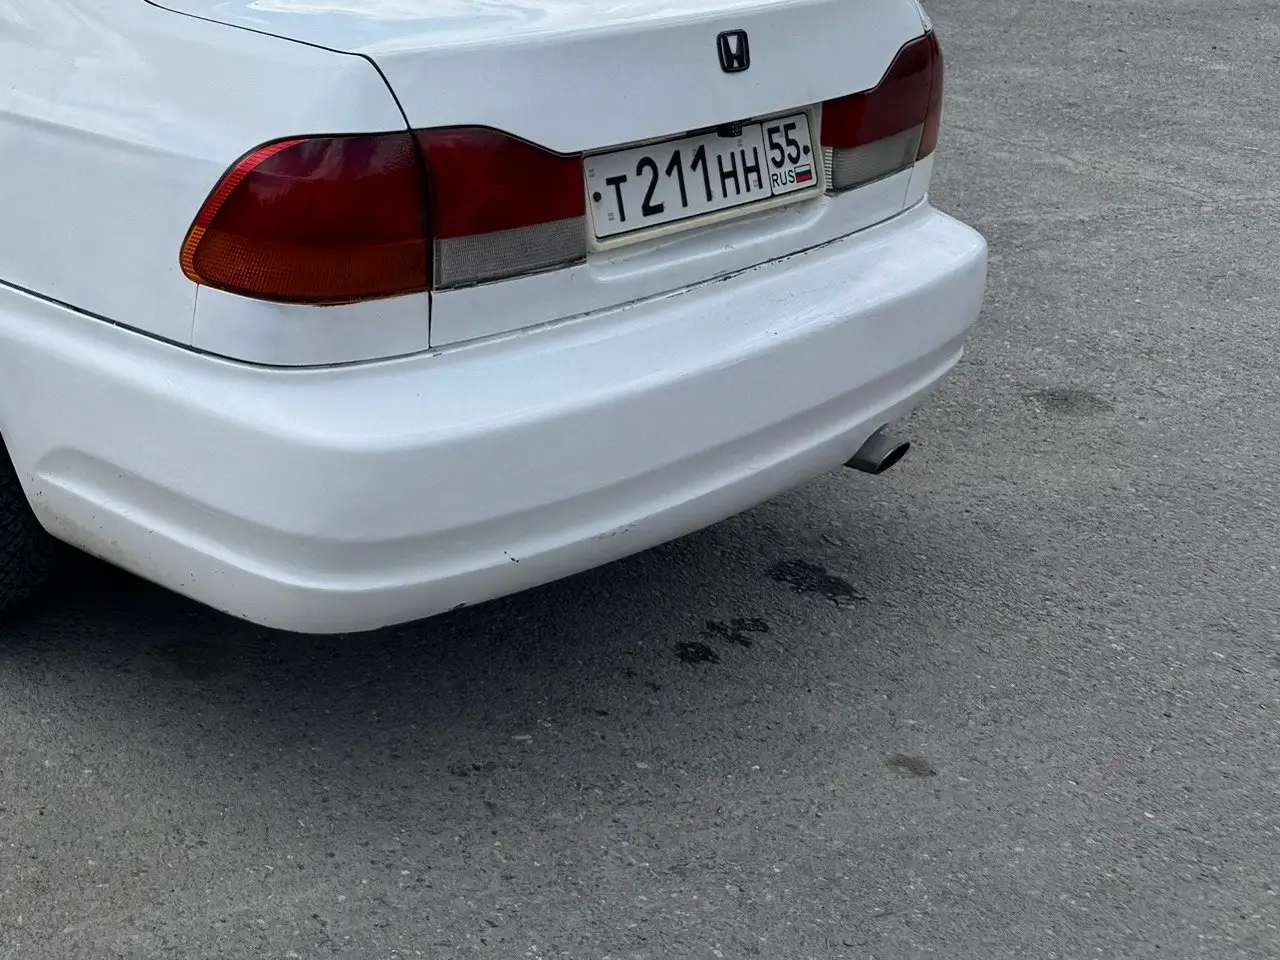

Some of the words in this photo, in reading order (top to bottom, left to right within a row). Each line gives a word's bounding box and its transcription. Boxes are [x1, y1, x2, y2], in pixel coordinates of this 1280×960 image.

[606, 145, 763, 222] Т211НН
[767, 122, 801, 168] 55
[772, 170, 795, 188] RUS
